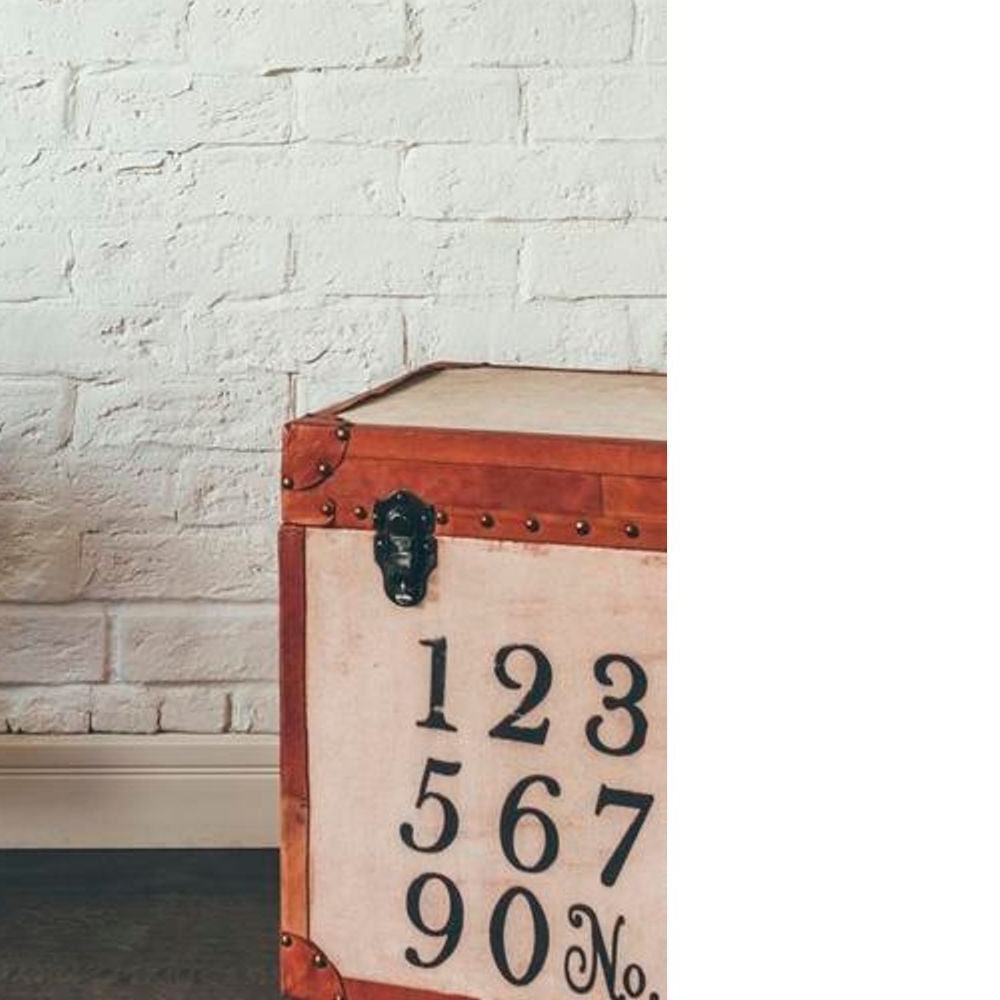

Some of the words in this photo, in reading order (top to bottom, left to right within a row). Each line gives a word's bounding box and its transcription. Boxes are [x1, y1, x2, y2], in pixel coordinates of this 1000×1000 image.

[416, 636, 458, 733] 1
[488, 643, 553, 746] 2
[585, 653, 648, 757] 3
[399, 757, 462, 854] 5
[499, 774, 561, 874] 6
[595, 783, 655, 888] 7
[404, 872, 464, 969] 9
[488, 885, 550, 987] 0
